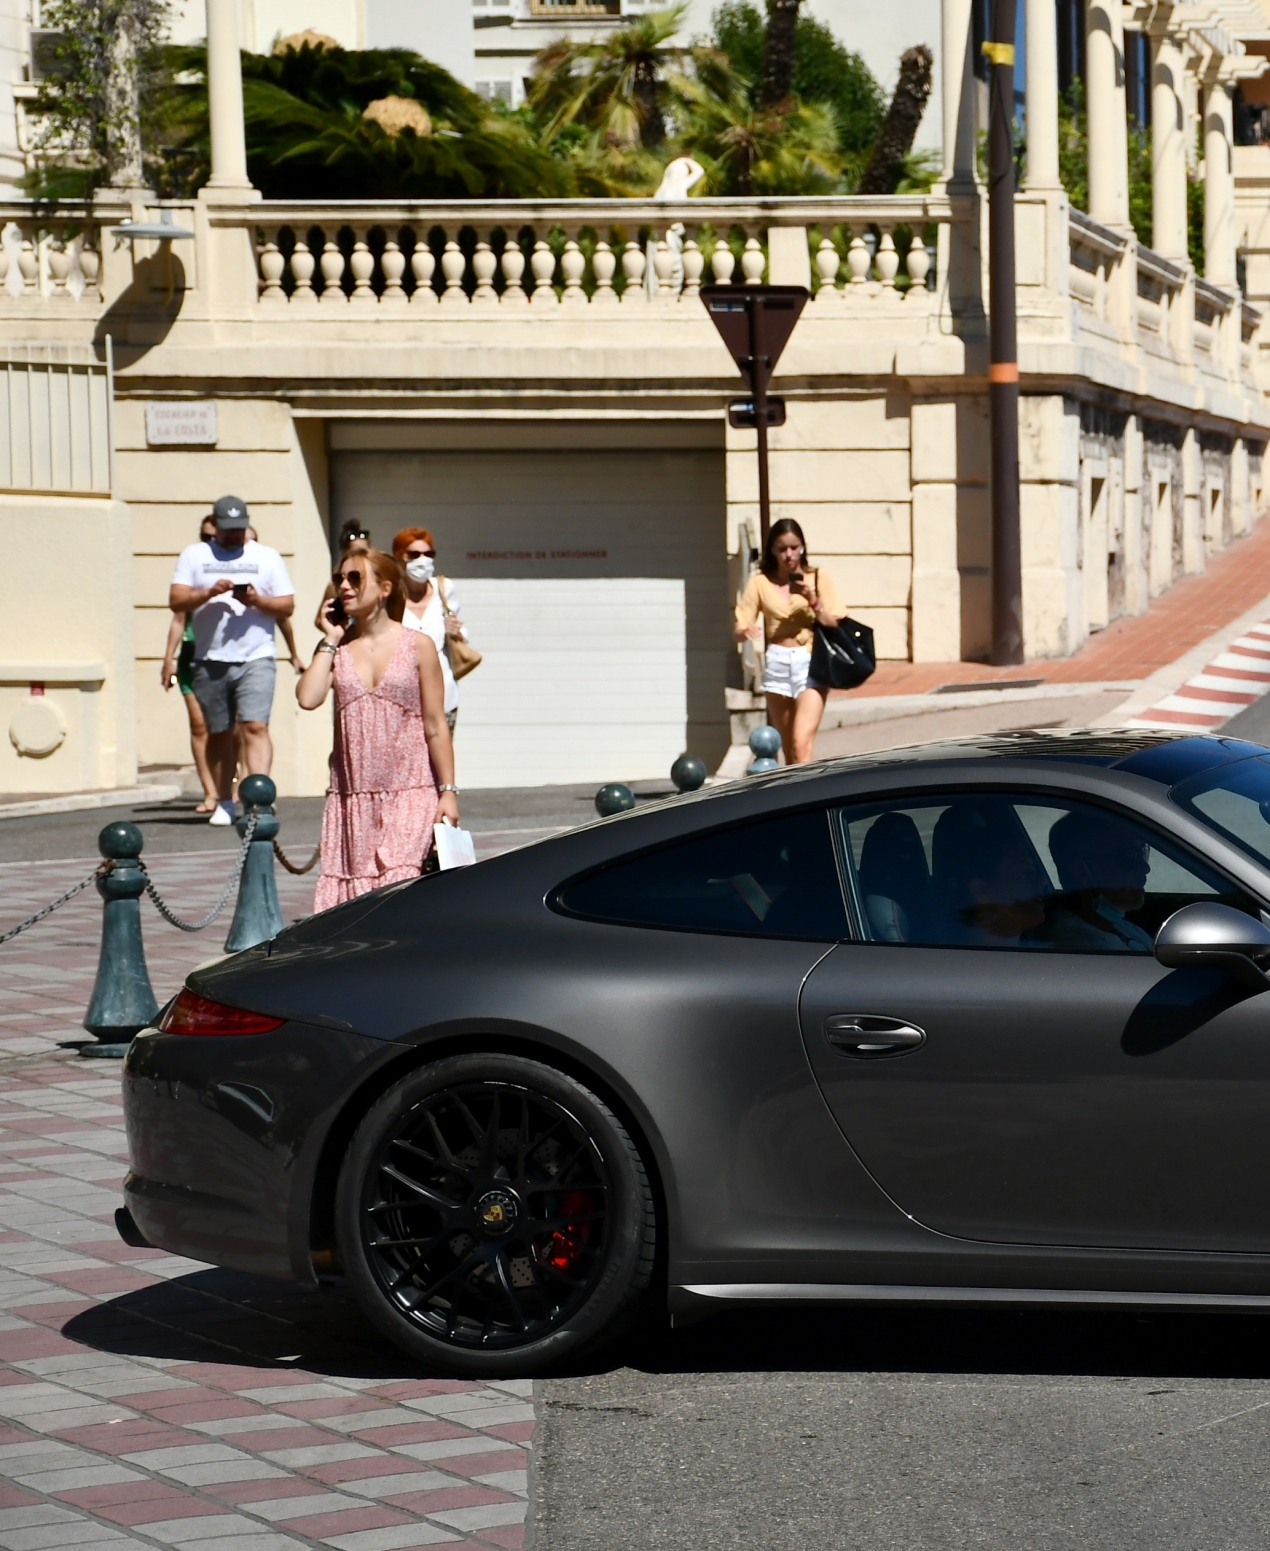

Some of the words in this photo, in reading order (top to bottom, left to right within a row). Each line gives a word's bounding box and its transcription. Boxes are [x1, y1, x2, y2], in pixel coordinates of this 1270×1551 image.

[155, 409, 196, 419] ESCALIER
[157, 426, 171, 436] LA
[175, 424, 207, 436] COSTA
[466, 551, 532, 560] INTERDICTION
[535, 550, 548, 560] DE
[551, 549, 608, 559] STATIONNER
